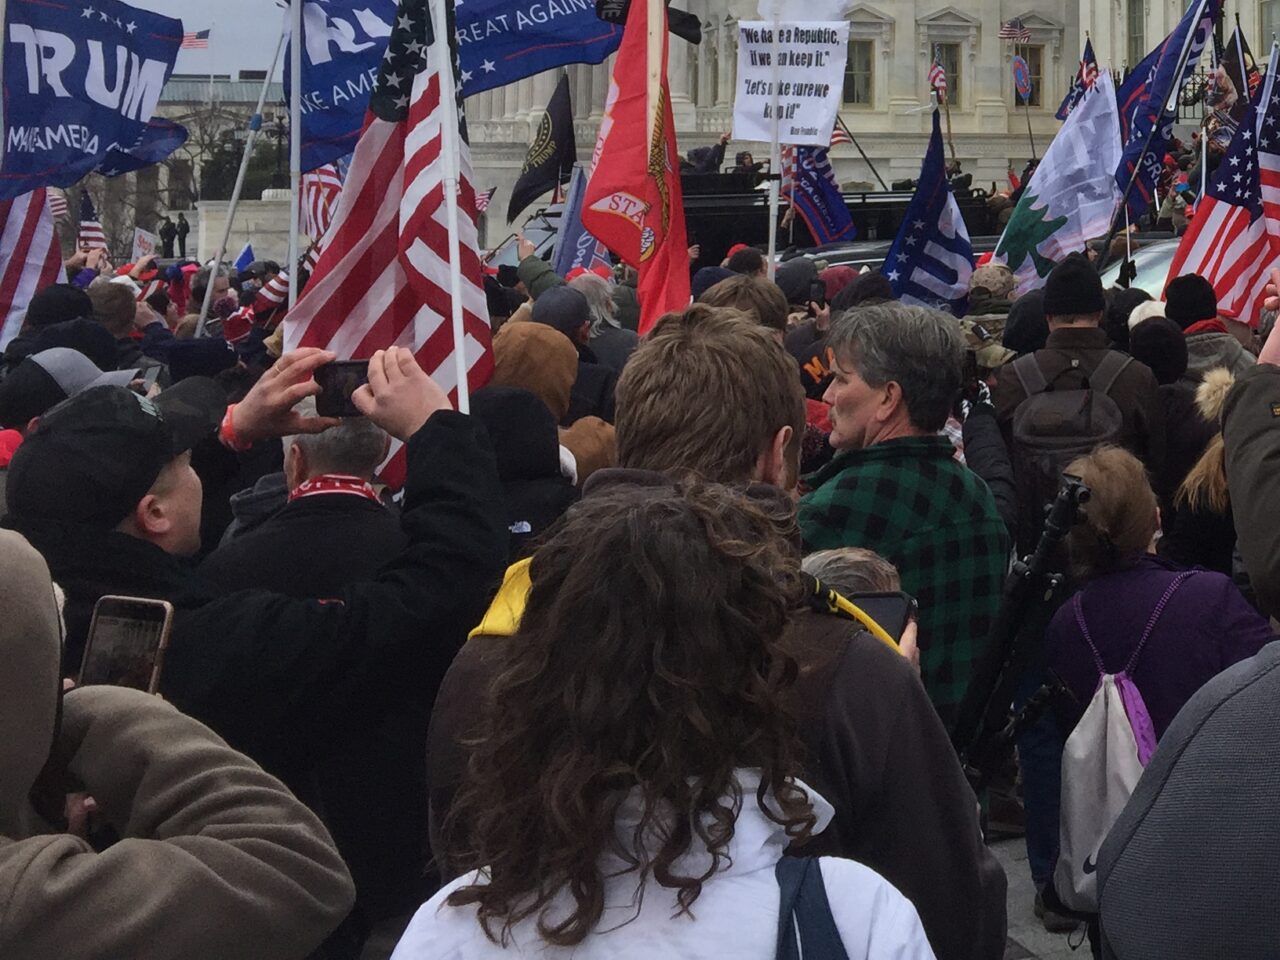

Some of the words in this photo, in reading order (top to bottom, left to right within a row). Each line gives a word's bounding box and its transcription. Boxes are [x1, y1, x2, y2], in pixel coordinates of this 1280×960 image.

[761, 27, 784, 44] hae
[789, 50, 813, 68] keep
[792, 83, 812, 97] sure
[814, 84, 830, 98] we
